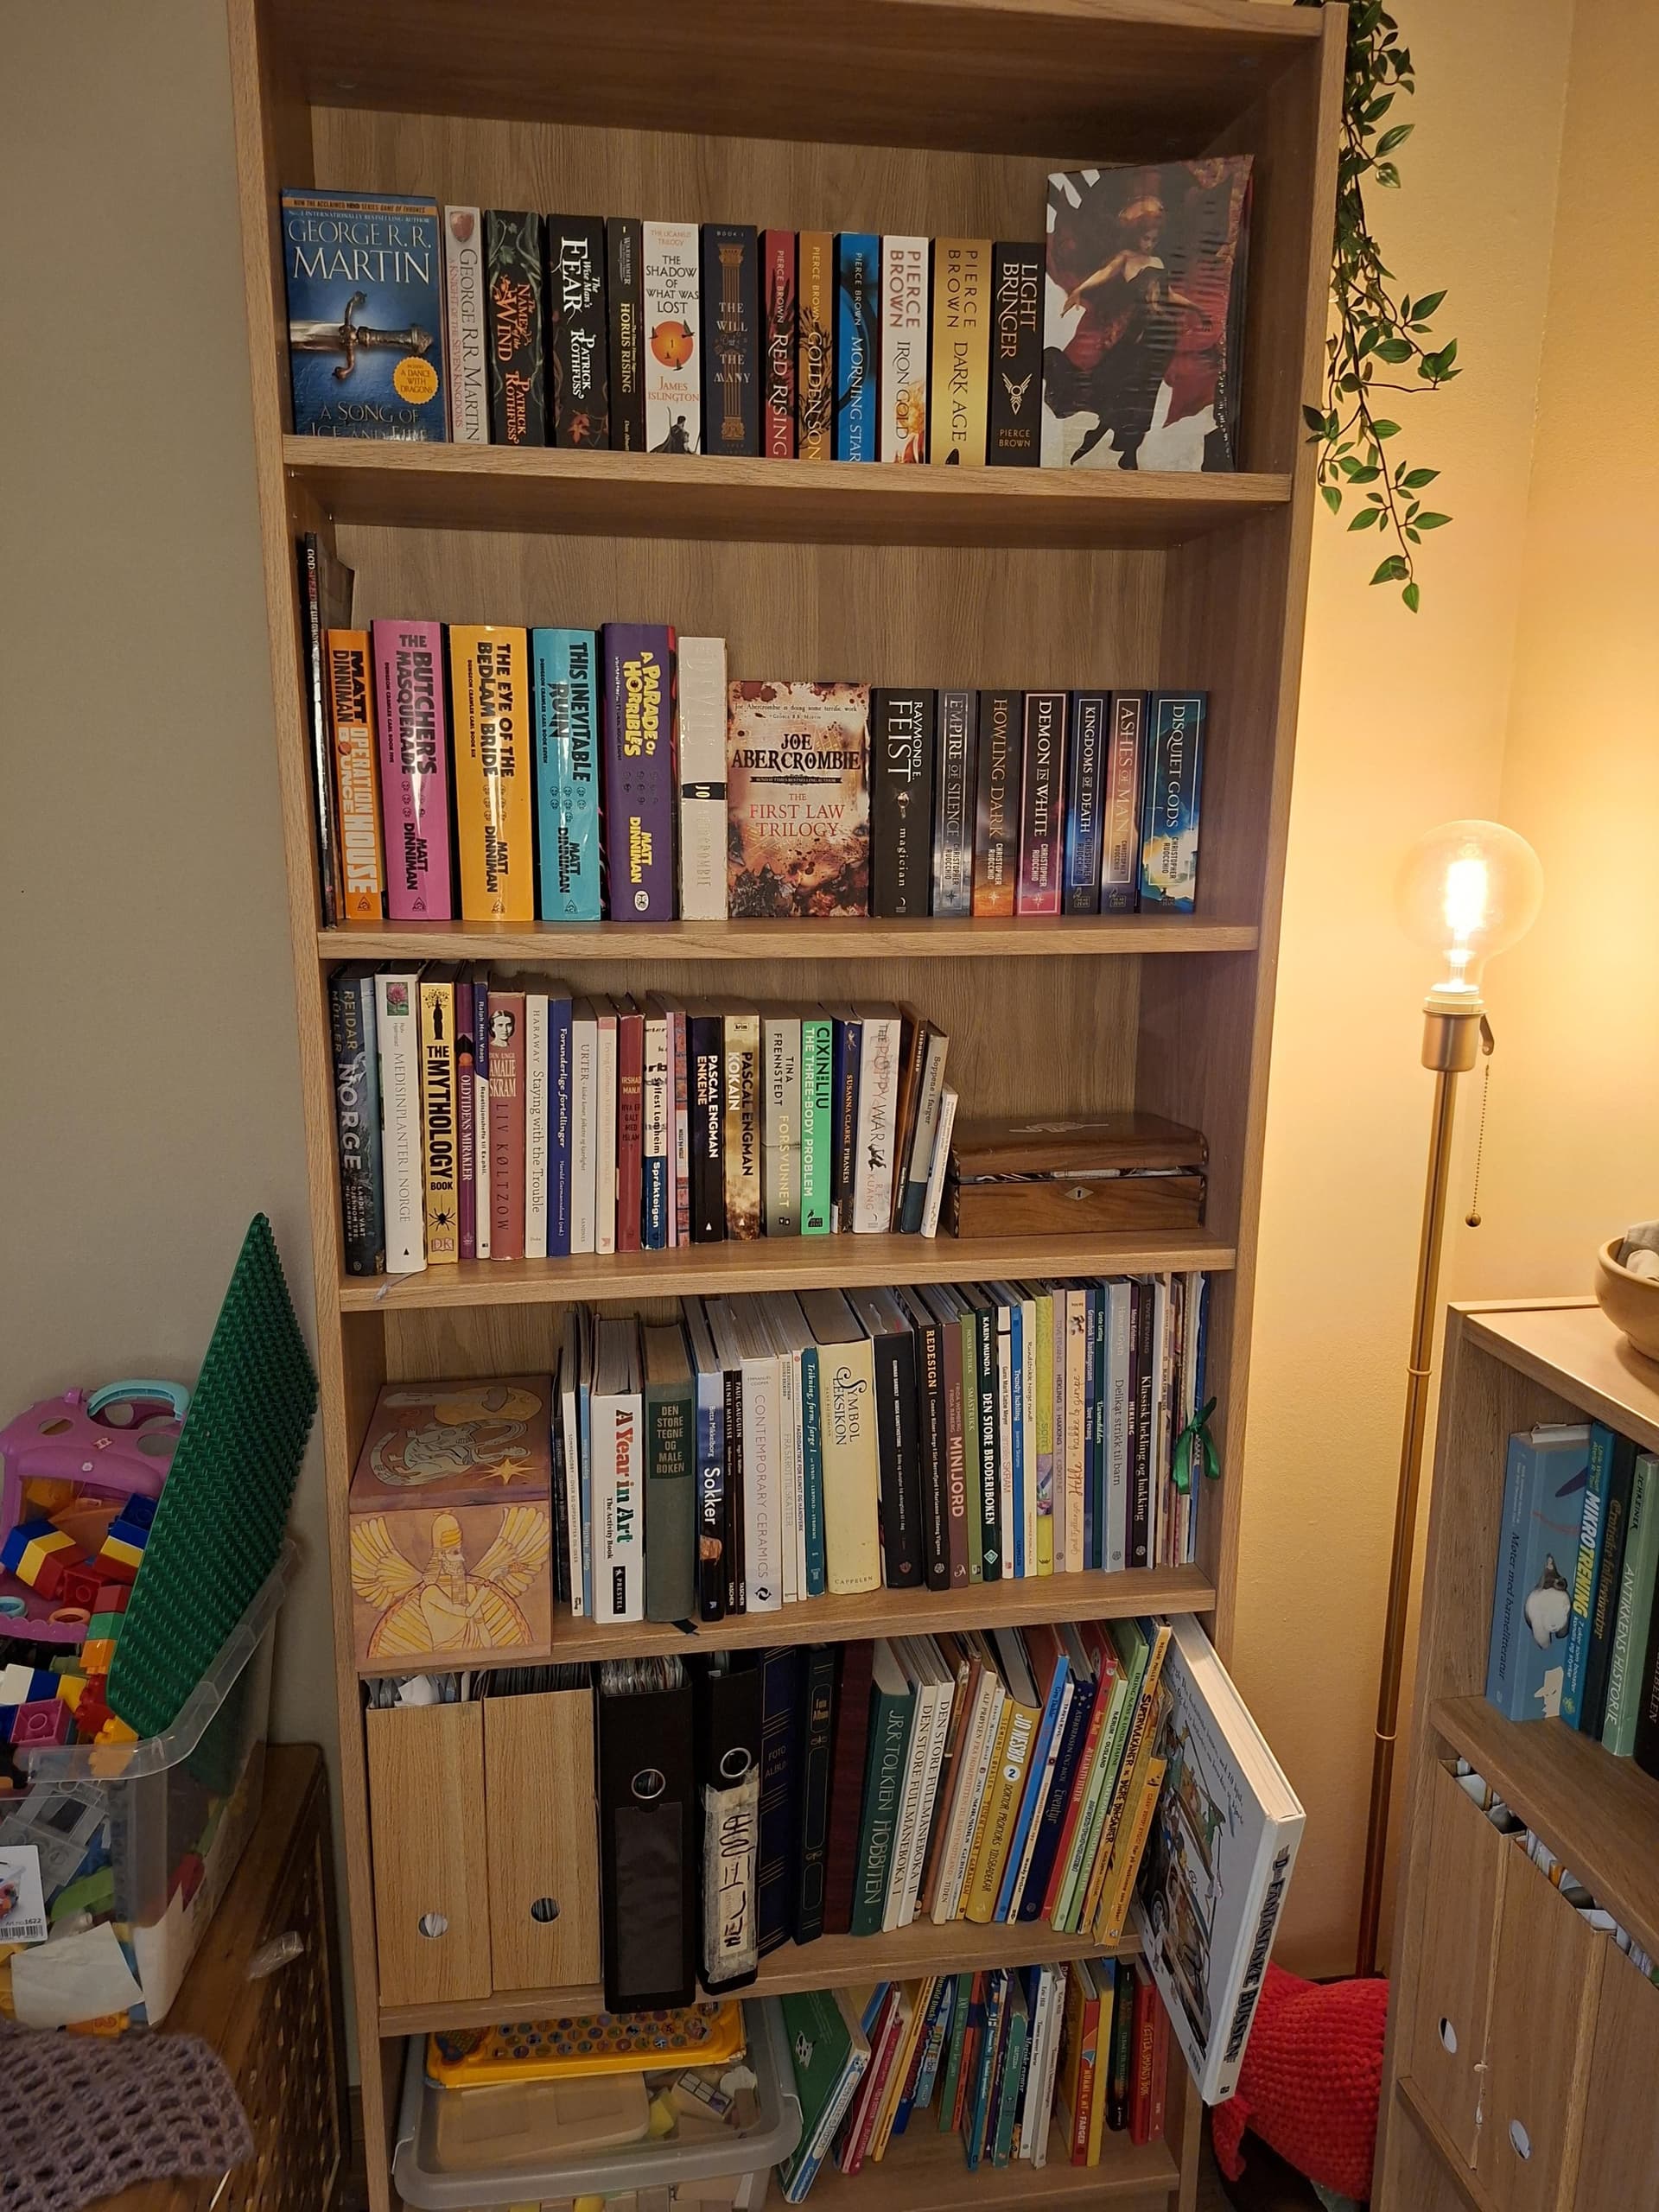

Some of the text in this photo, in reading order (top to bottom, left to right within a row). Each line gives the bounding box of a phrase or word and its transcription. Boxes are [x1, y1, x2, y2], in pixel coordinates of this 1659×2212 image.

[289, 219, 431, 252] GEORGE R. R.
[663, 256, 682, 265] THE
[293, 246, 430, 286] MARTIN
[556, 236, 589, 316] FEAR
[582, 261, 594, 310] Wise Man's
[591, 276, 601, 294] The
[646, 266, 697, 277] SHADOW
[646, 289, 699, 301] WHAT WAS
[890, 249, 905, 328] BROWN
[906, 250, 920, 329] PIERCE
[946, 249, 961, 328] BROWN
[963, 250, 978, 329] PIERCE
[658, 302, 689, 315] LOST
[716, 320, 748, 333] WILL
[718, 302, 744, 314] THE
[997, 262, 1020, 359] BRINGER
[1020, 263, 1039, 333] LIGHT
[569, 328, 585, 400] ROTHFUSS
[586, 333, 597, 391] PATRICK
[620, 303, 632, 397] HORUS RISING
[714, 372, 751, 385] MANY
[720, 353, 746, 365] THE
[321, 400, 420, 423] A SONG OF
[648, 391, 700, 404] ISLINGTON
[660, 376, 689, 392] JAMES
[768, 334, 789, 456] RED RISING
[948, 341, 969, 443] DARK AGE
[398, 633, 428, 650] THE
[332, 649, 351, 724] DINNIMAN
[352, 650, 368, 725] MATT
[395, 649, 417, 776] MASQUERADE
[412, 651, 438, 776] BUTCHER'S
[488, 643, 516, 779] THE EYE OF THE
[547, 679, 570, 739] RUIN
[622, 661, 642, 758] HORRIBLES
[731, 750, 861, 772] ABERCROMBIE
[781, 734, 813, 750] JOE
[887, 700, 912, 783] FEIST
[988, 699, 1007, 839] HOWLING DARK
[1033, 700, 1052, 837] DEMON IN WHITE
[1166, 705, 1186, 828] DISQUIET GODS
[348, 727, 374, 818] OPERATION
[750, 804, 846, 819] FIRST LAW
[758, 823, 840, 838] TRILOGY
[343, 816, 379, 896] HOUSE
[404, 822, 419, 892] DINNIMAN
[415, 837, 429, 872] MATT
[484, 825, 500, 893] DINNIMAN
[557, 827, 571, 894] DINNIMAN
[629, 816, 642, 884] DINNIMAN
[896, 827, 908, 887] magician
[344, 990, 359, 1051] REIDAR
[427, 1045, 449, 1058] THE
[489, 1059, 516, 1077] AMALIE
[580, 1044, 590, 1082] URTER
[696, 1056, 708, 1106] ENKENE
[773, 1033, 783, 1106] FRENNSTEDT
[785, 1056, 794, 1083] TINA
[816, 1026, 830, 1109] CIXIN LIU
[489, 1078, 517, 1097] SKRAM
[530, 1071, 544, 1115] Staying
[708, 1055, 720, 1159] PASCAL ENGMAN
[728, 1052, 741, 1111] KOKAIN
[337, 1062, 362, 1171] NORGE
[427, 1059, 454, 1179] MYTHOLOGY
[532, 1116, 544, 1145] with
[741, 1052, 754, 1176] PASCAL ENGMAN
[804, 1027, 815, 1197] THE THREE-BODY PROBLEM
[842, 1073, 854, 1184] SUSANNA CLARKE PIRANESI
[430, 1180, 454, 1191] BOOK
[496, 1103, 509, 1231] LIV KØLTZOW
[532, 1147, 544, 1166] the
[779, 1115, 790, 1208] FORSVUNNET
[532, 1168, 545, 1214] Trouble
[925, 1330, 938, 1388] REDESIGN
[982, 1317, 991, 1376] KARIN MUNDAL
[657, 1418, 683, 1427] STORE
[657, 1428, 683, 1439] TEGNE
[661, 1406, 679, 1416] DEN
[831, 1377, 848, 1446] LEKSIKON
[836, 1366, 868, 1443] SYMBOL
[657, 1464, 685, 1474] BOKEN
[658, 1452, 683, 1463] MALE
[665, 1440, 677, 1451] OG
[982, 1392, 995, 1524] DEN STORE BRODERIBOKEN
[615, 1409, 635, 1543] A Year in Art
[703, 1467, 722, 1525] Sokker
[754, 1395, 769, 1579] CONTEMPORARY CERAMICS
[949, 1436, 965, 1517] MINIJORD
[1001, 1460, 1012, 1493] SKRAM
[604, 1511, 613, 1539] Activity
[834, 1575, 874, 1586] CAPPELEN
[1606, 1562, 1635, 1726] ANTIKKENS HISTORIE
[1014, 1713, 1033, 1730] JO
[877, 1744, 900, 1811] TOLKIEN
[999, 1783, 1014, 1811] DOKTOR
[1007, 1769, 1016, 1778] 2
[991, 1812, 1009, 1847] PROKTORS
[864, 1819, 893, 1904] HOBBITEN
